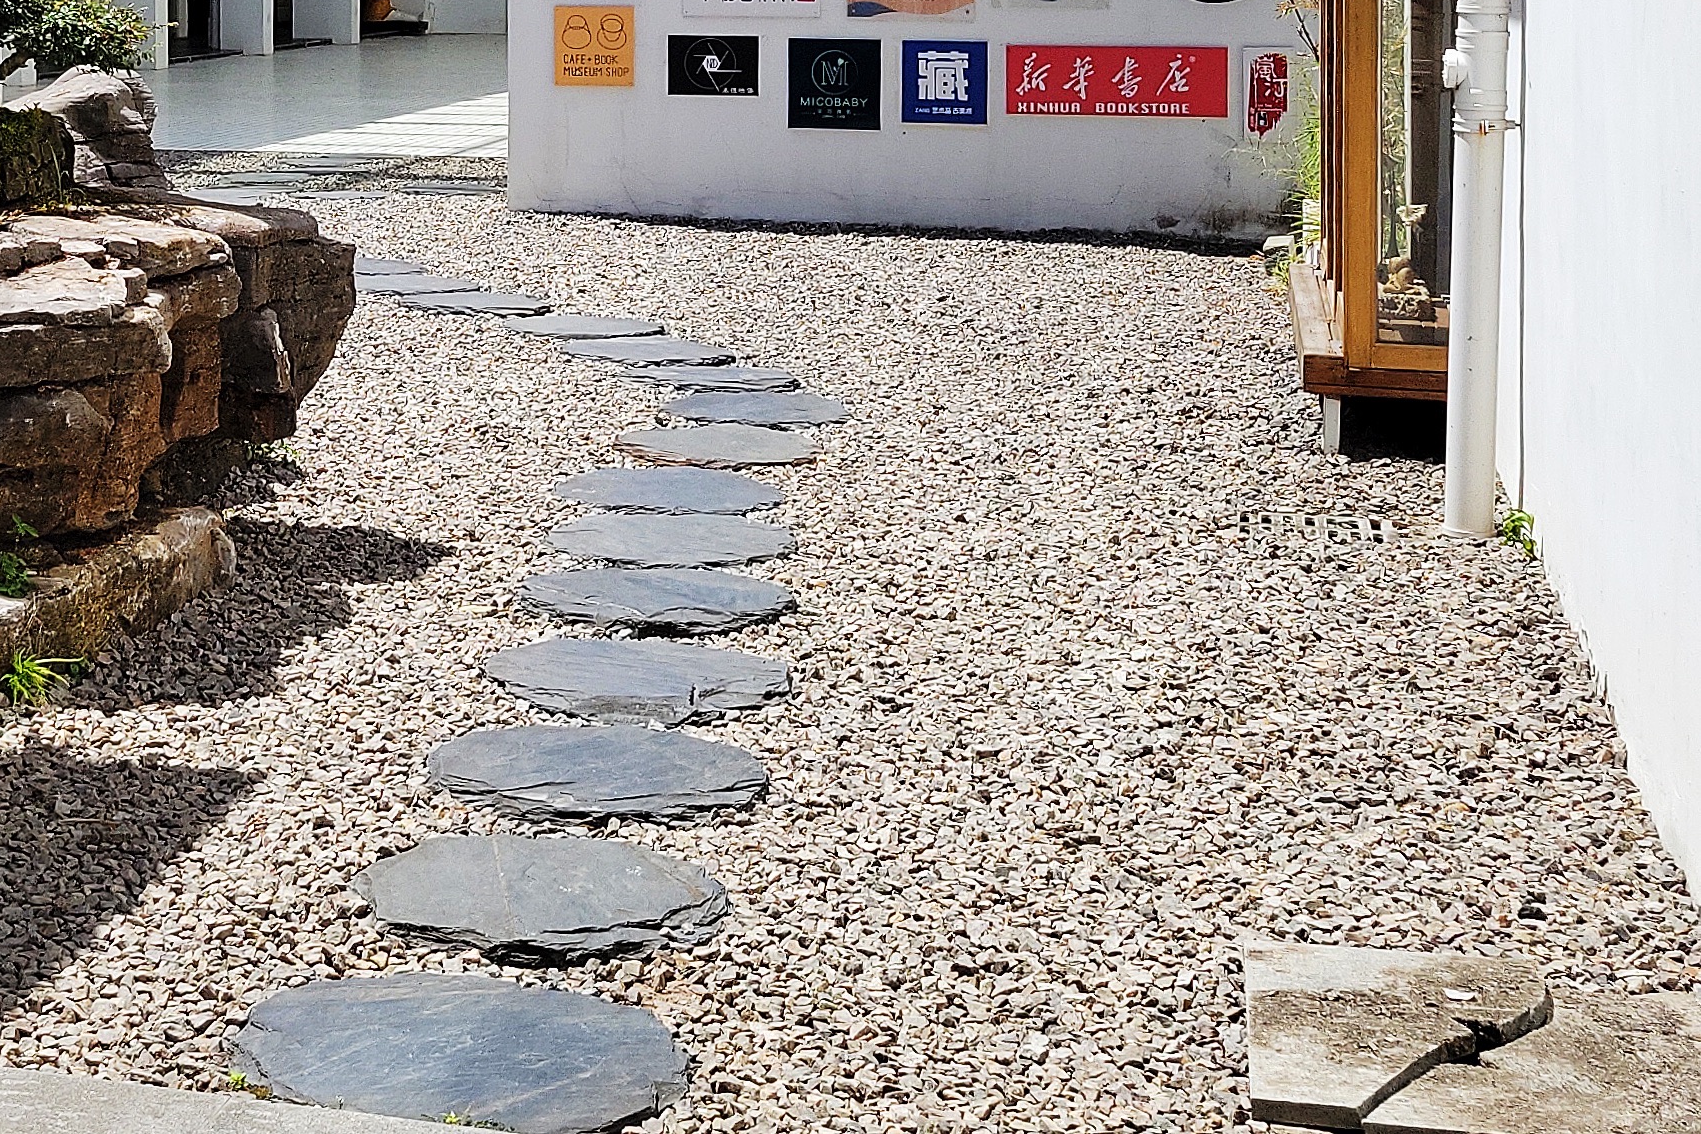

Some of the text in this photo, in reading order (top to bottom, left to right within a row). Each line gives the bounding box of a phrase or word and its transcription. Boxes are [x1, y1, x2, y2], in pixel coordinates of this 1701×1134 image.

[563, 54, 586, 64] CAFE
[594, 54, 618, 65] BOOK
[563, 66, 630, 77] MUSEUM SHOP
[917, 50, 969, 102] 藏
[800, 97, 868, 107] MICOBABY
[1018, 102, 1190, 114] XINHUA BOOKSTORE
